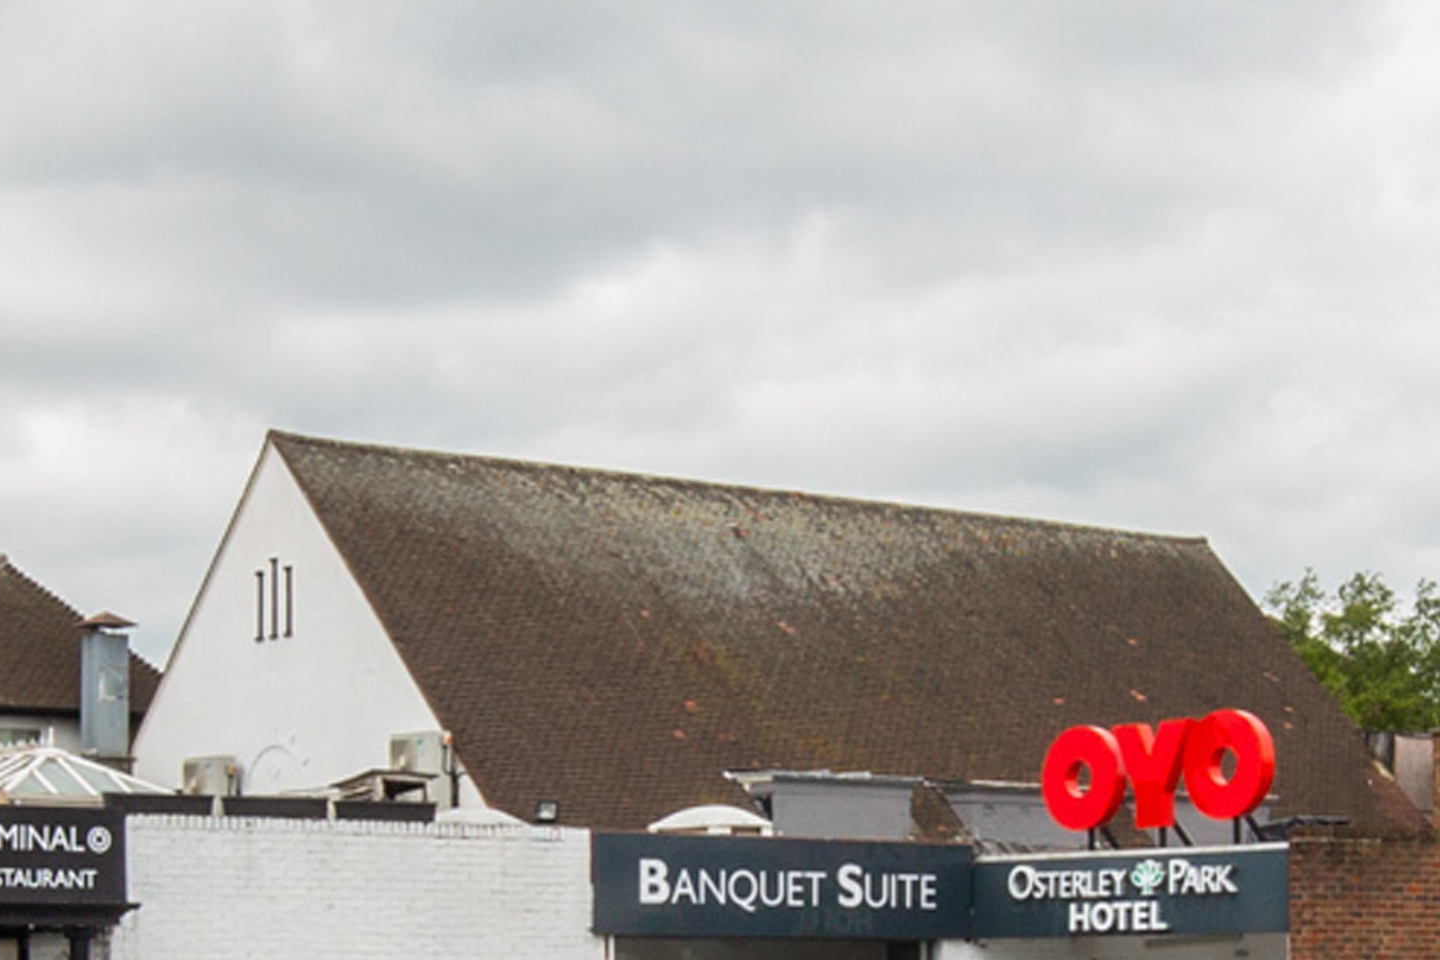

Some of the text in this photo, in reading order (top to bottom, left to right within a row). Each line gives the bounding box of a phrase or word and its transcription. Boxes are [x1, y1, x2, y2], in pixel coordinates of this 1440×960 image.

[1042, 708, 1276, 832] OYO
[639, 858, 937, 912] BANQUET SUITE
[1008, 859, 1238, 899] OSTERLEY PARK
[1068, 901, 1168, 932] HOTEL
